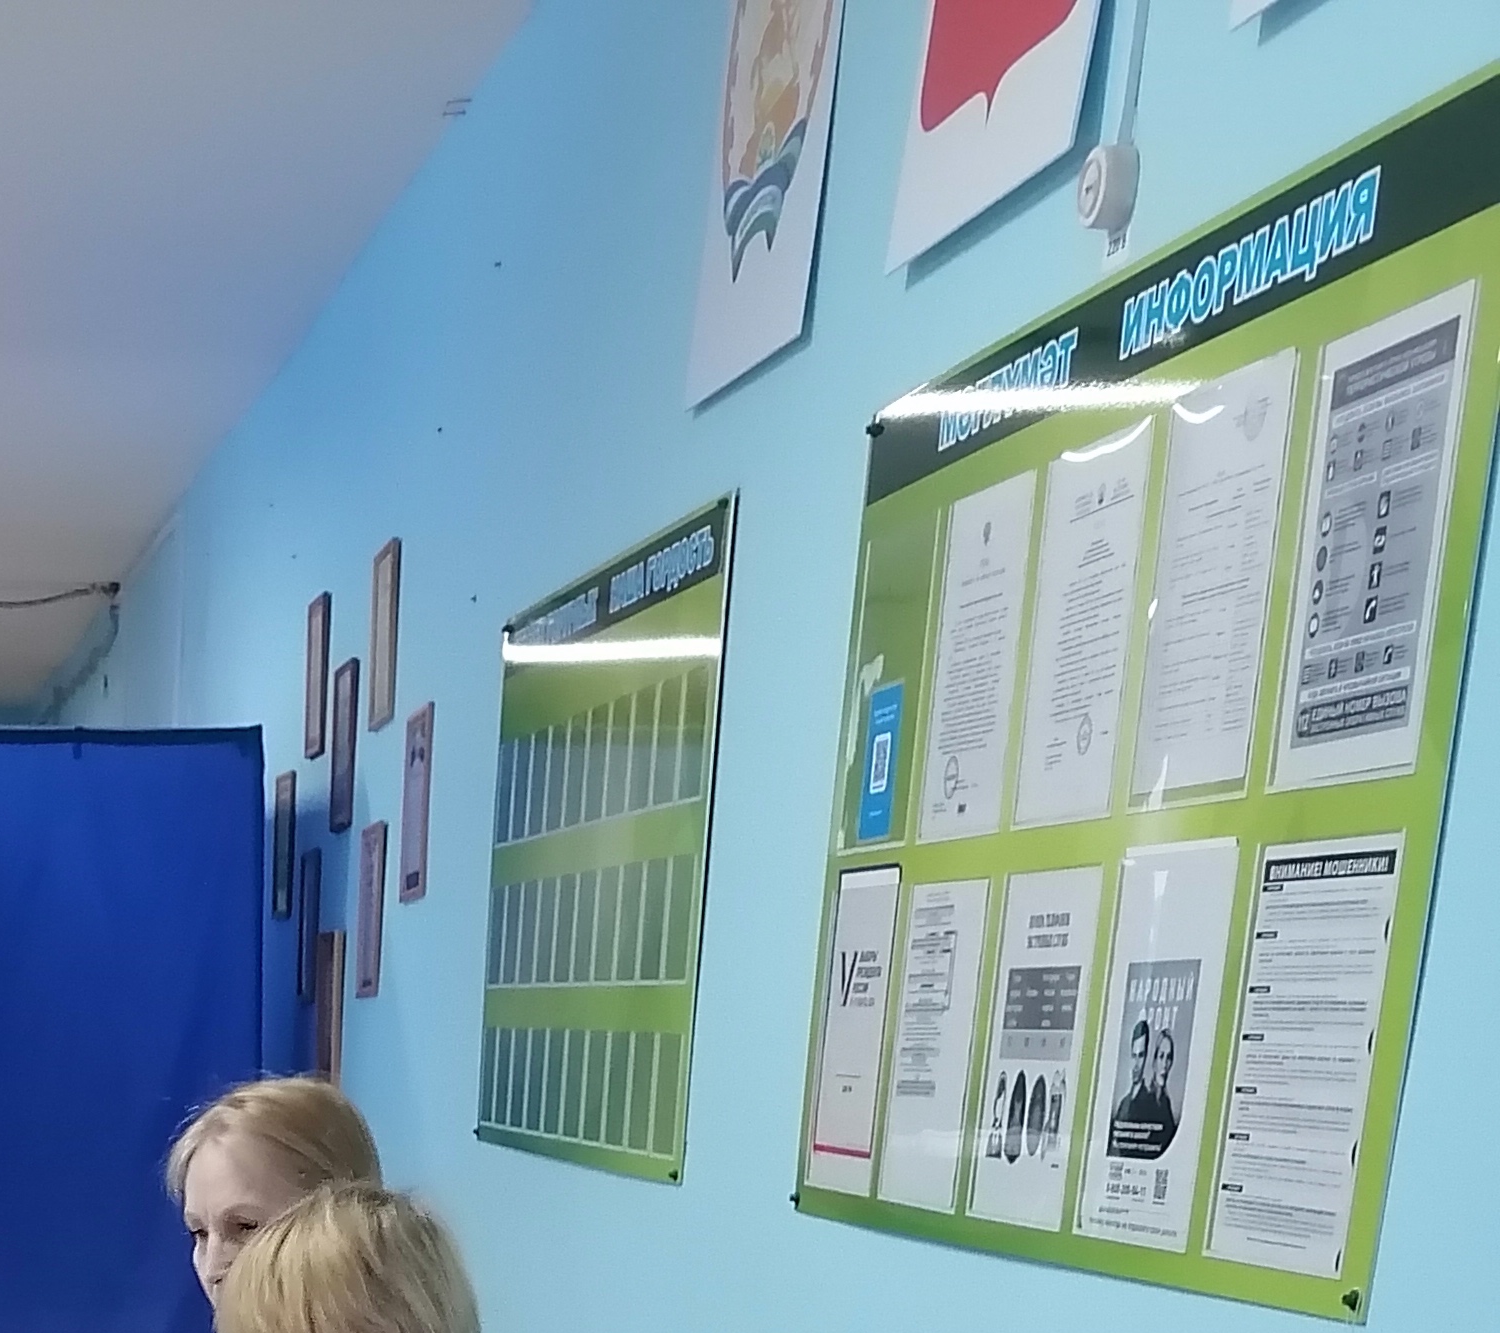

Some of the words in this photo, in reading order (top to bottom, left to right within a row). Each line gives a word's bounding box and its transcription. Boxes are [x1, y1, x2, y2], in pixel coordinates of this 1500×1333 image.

[1118, 165, 1382, 360] ИНФОРМАЦИЯ
[1268, 861, 1322, 881] ВНИМАНИЕ!
[1323, 856, 1390, 877] МОШЕННИКИ!
[1128, 971, 1195, 1004] НАРОДНЫЙ
